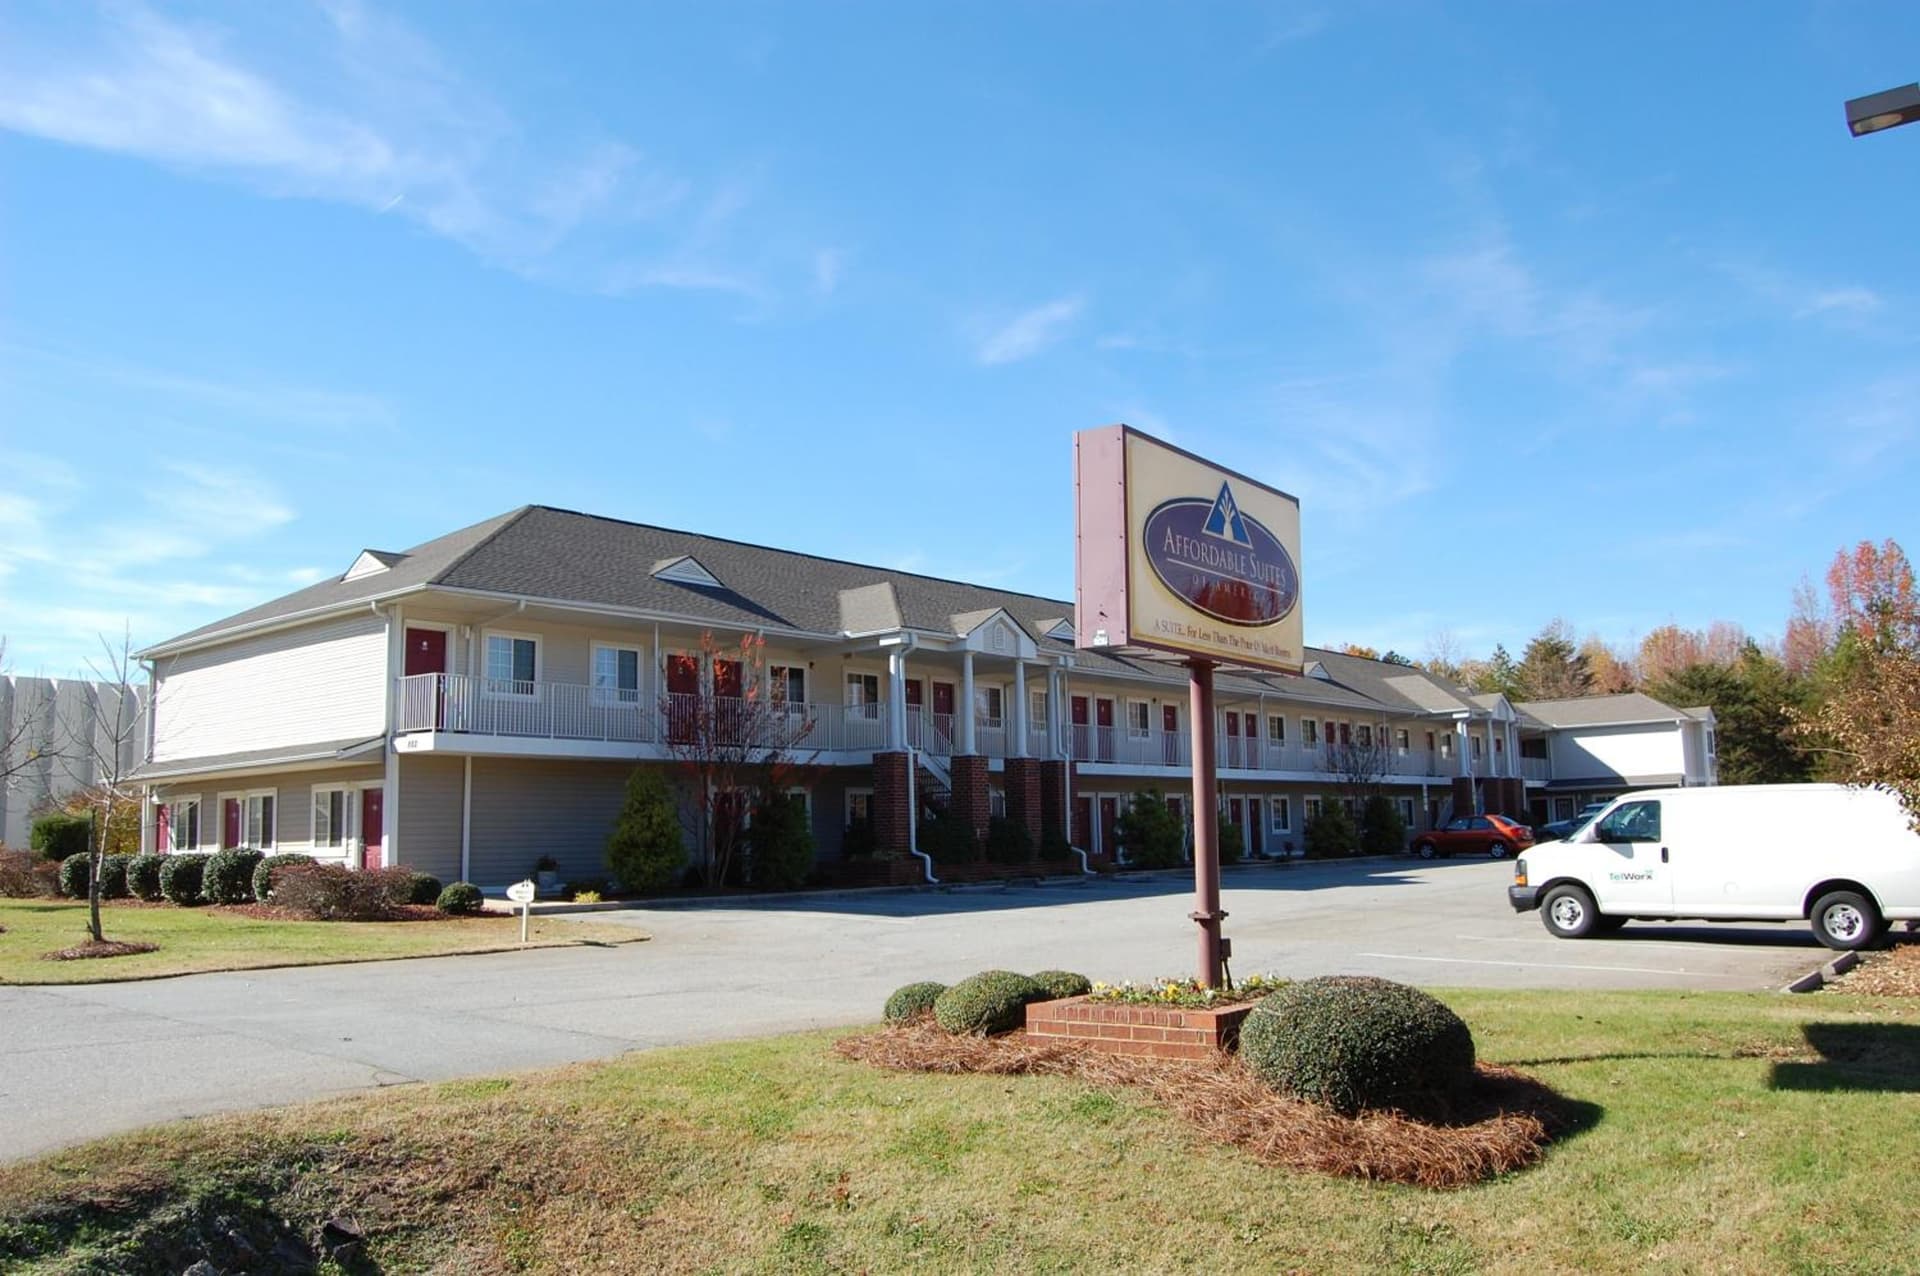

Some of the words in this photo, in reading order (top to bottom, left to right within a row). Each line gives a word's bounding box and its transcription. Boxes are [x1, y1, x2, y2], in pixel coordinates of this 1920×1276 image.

[1163, 525, 1246, 575] AFFORDABLE
[1249, 552, 1286, 588] SUITES
[1187, 625, 1198, 639] For
[1199, 626, 1211, 641] Less
